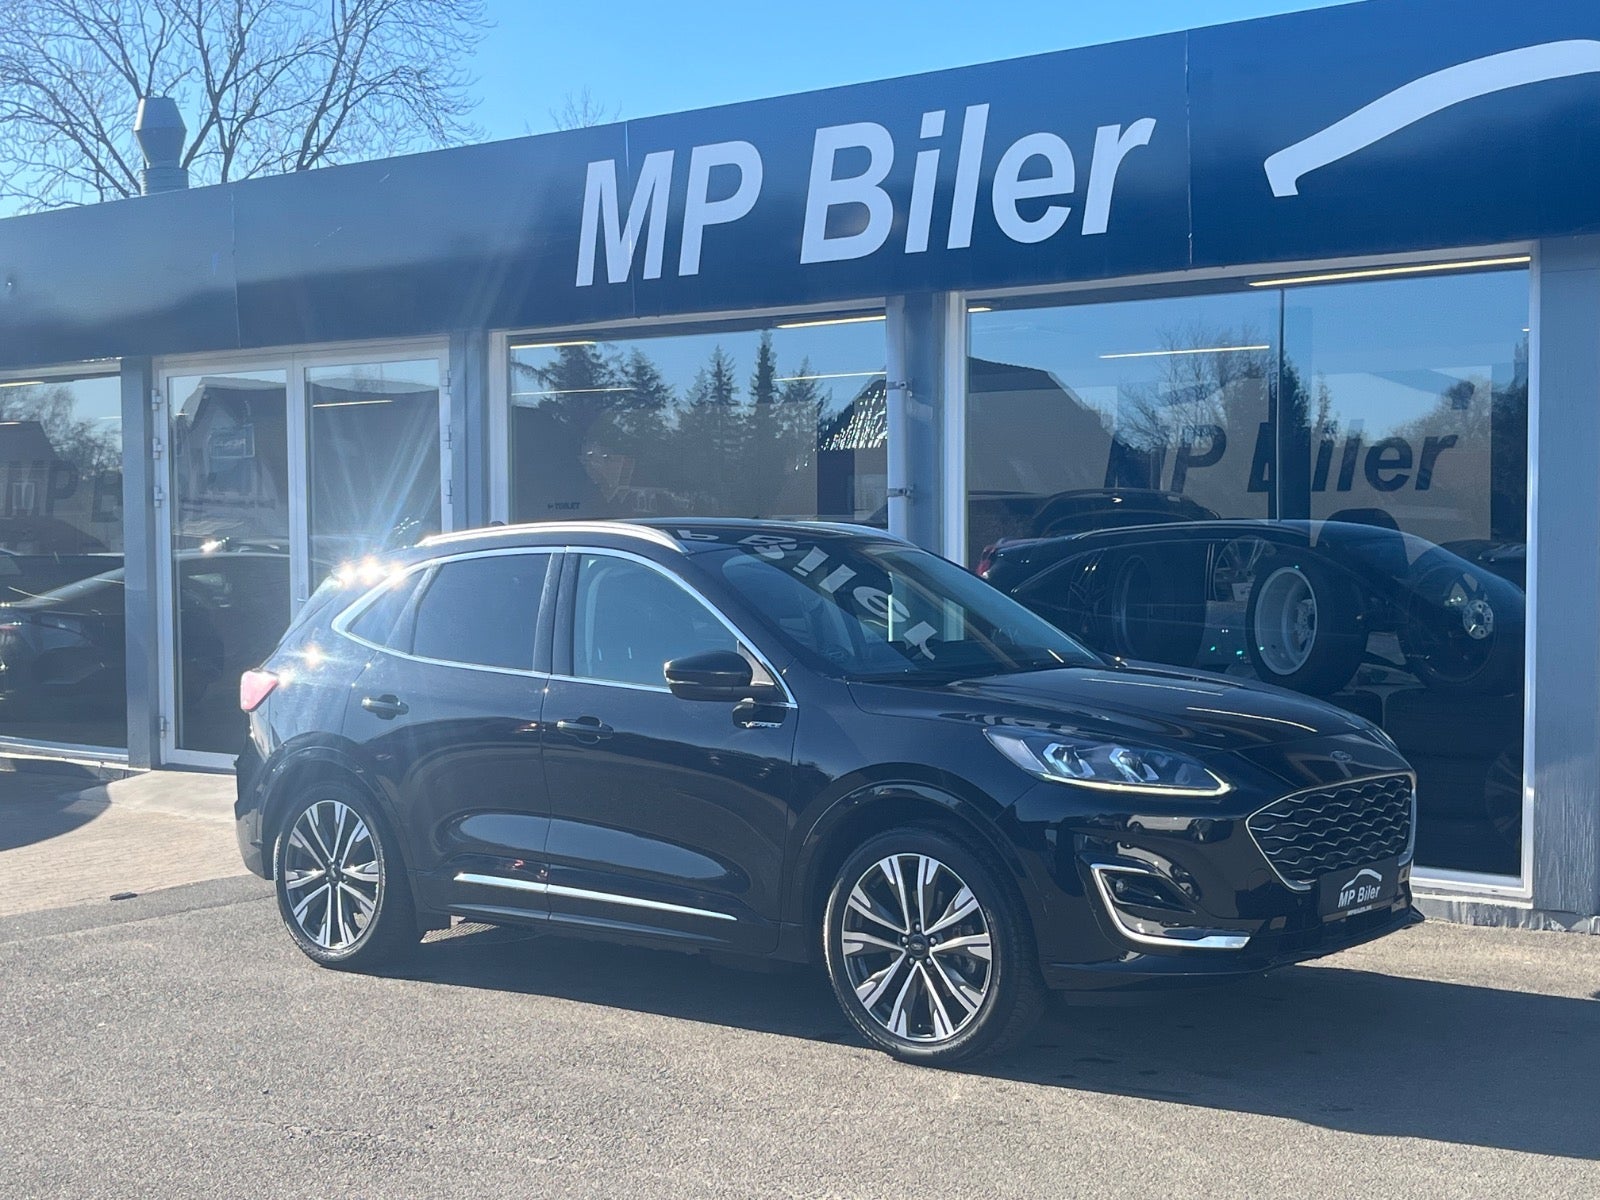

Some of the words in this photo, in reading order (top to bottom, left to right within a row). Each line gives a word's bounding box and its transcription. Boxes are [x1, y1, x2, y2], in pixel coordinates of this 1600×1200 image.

[575, 140, 763, 287] MP
[800, 103, 1157, 265] Biler
[1338, 889, 1356, 909] MP
[1357, 885, 1381, 903] Biler
